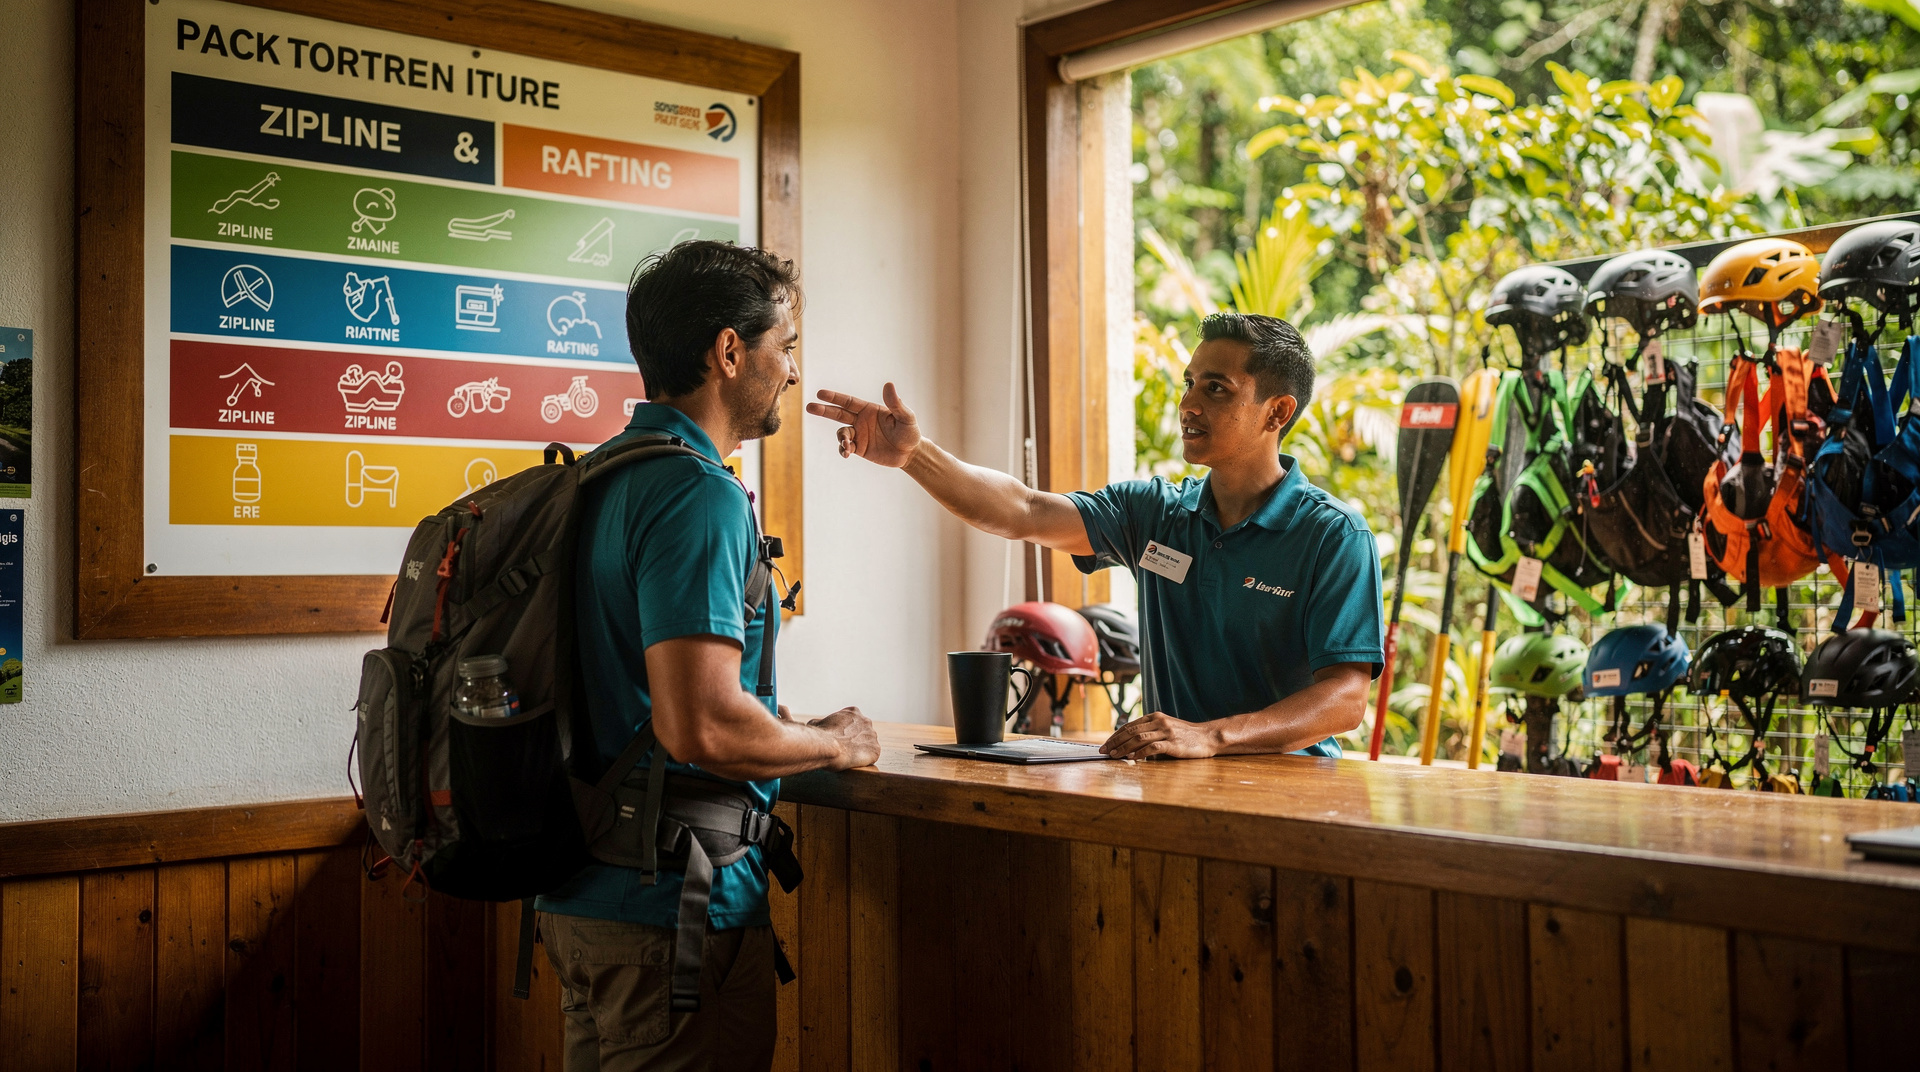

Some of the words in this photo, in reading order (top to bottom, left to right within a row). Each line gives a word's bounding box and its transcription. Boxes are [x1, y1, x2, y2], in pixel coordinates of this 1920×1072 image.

[176, 18, 280, 65] PACK
[288, 38, 454, 94] TORTREN
[467, 68, 560, 110] ITURE
[259, 104, 401, 154] ZIPLINE
[453, 132, 480, 165] &
[541, 145, 673, 189] RAFTING
[218, 222, 273, 241] ZIPLINE
[347, 236, 400, 255] ZMAINE
[219, 315, 275, 333] ZIPLINE
[546, 339, 599, 357] RAFTING
[218, 409, 275, 425] ZIPLINE
[344, 415, 397, 430] ZIPLINE
[233, 505, 260, 518] ERE
